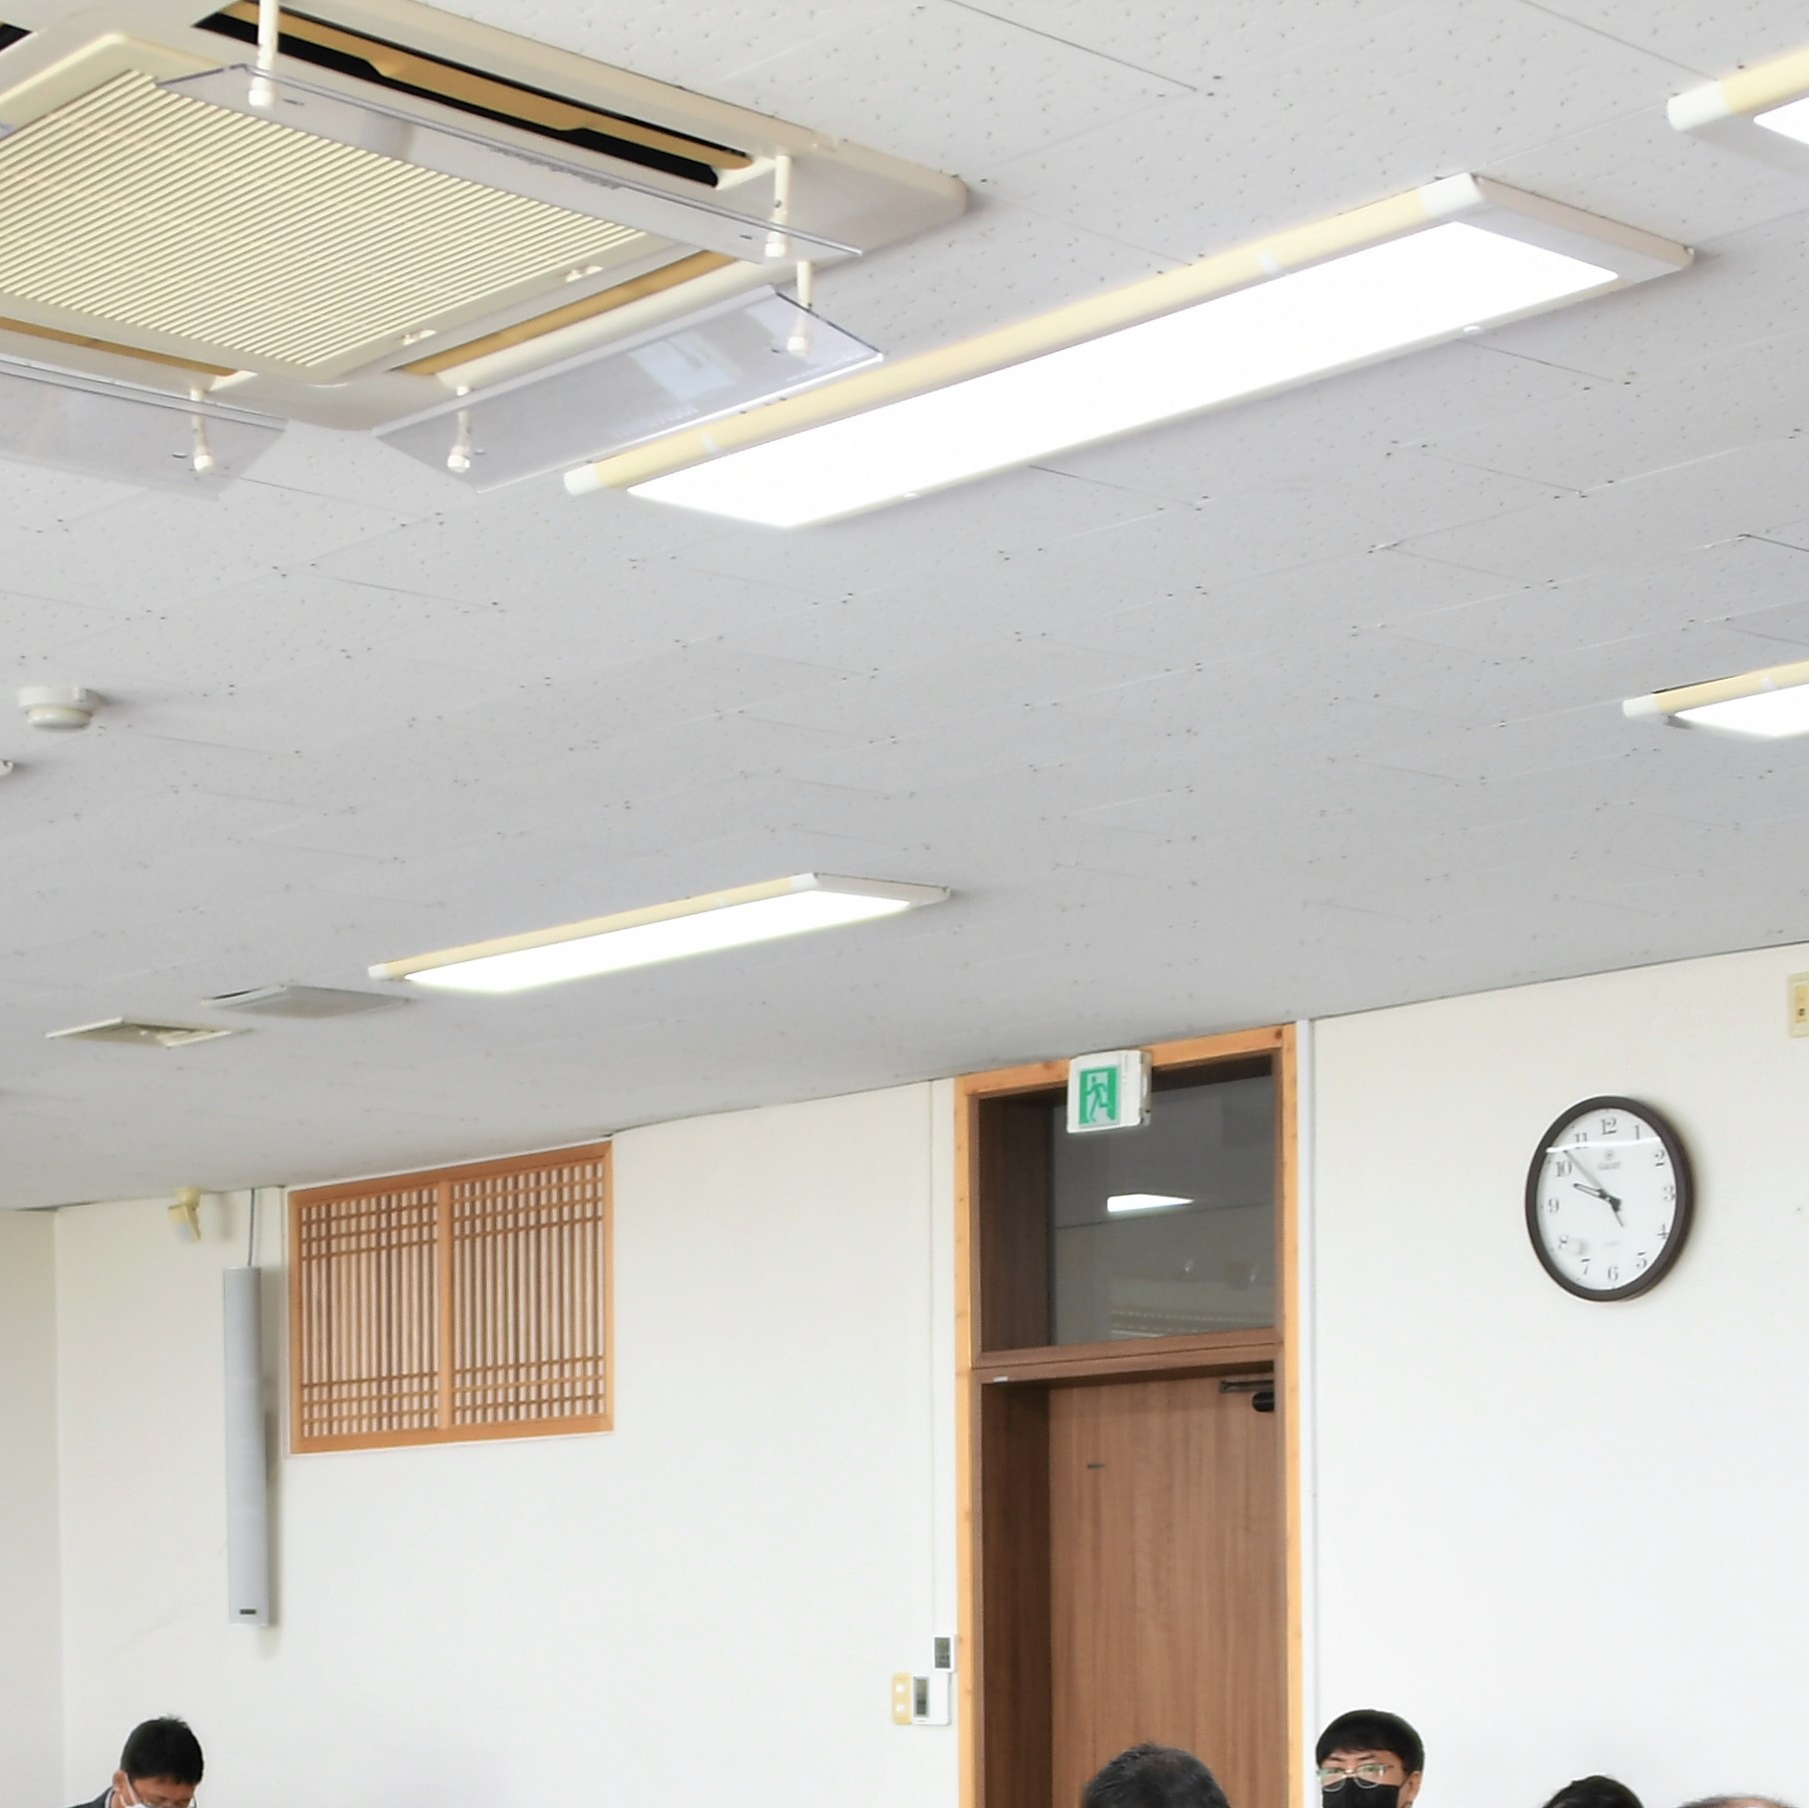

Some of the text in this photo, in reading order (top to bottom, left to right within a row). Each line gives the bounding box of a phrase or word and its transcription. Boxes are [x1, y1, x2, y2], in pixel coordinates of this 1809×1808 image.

[1600, 1117, 1617, 1135] 12
[1634, 1125, 1641, 1140] 1
[1575, 1132, 1588, 1149] 11
[1654, 1149, 1666, 1167] 2
[1555, 1161, 1572, 1177] 10
[1663, 1185, 1675, 1202] 3
[1548, 1198, 1560, 1214] 9
[1657, 1223, 1669, 1240] 4
[1581, 1258, 1590, 1275] 7
[1636, 1251, 1647, 1269] 5
[1608, 1265, 1619, 1282] 6
